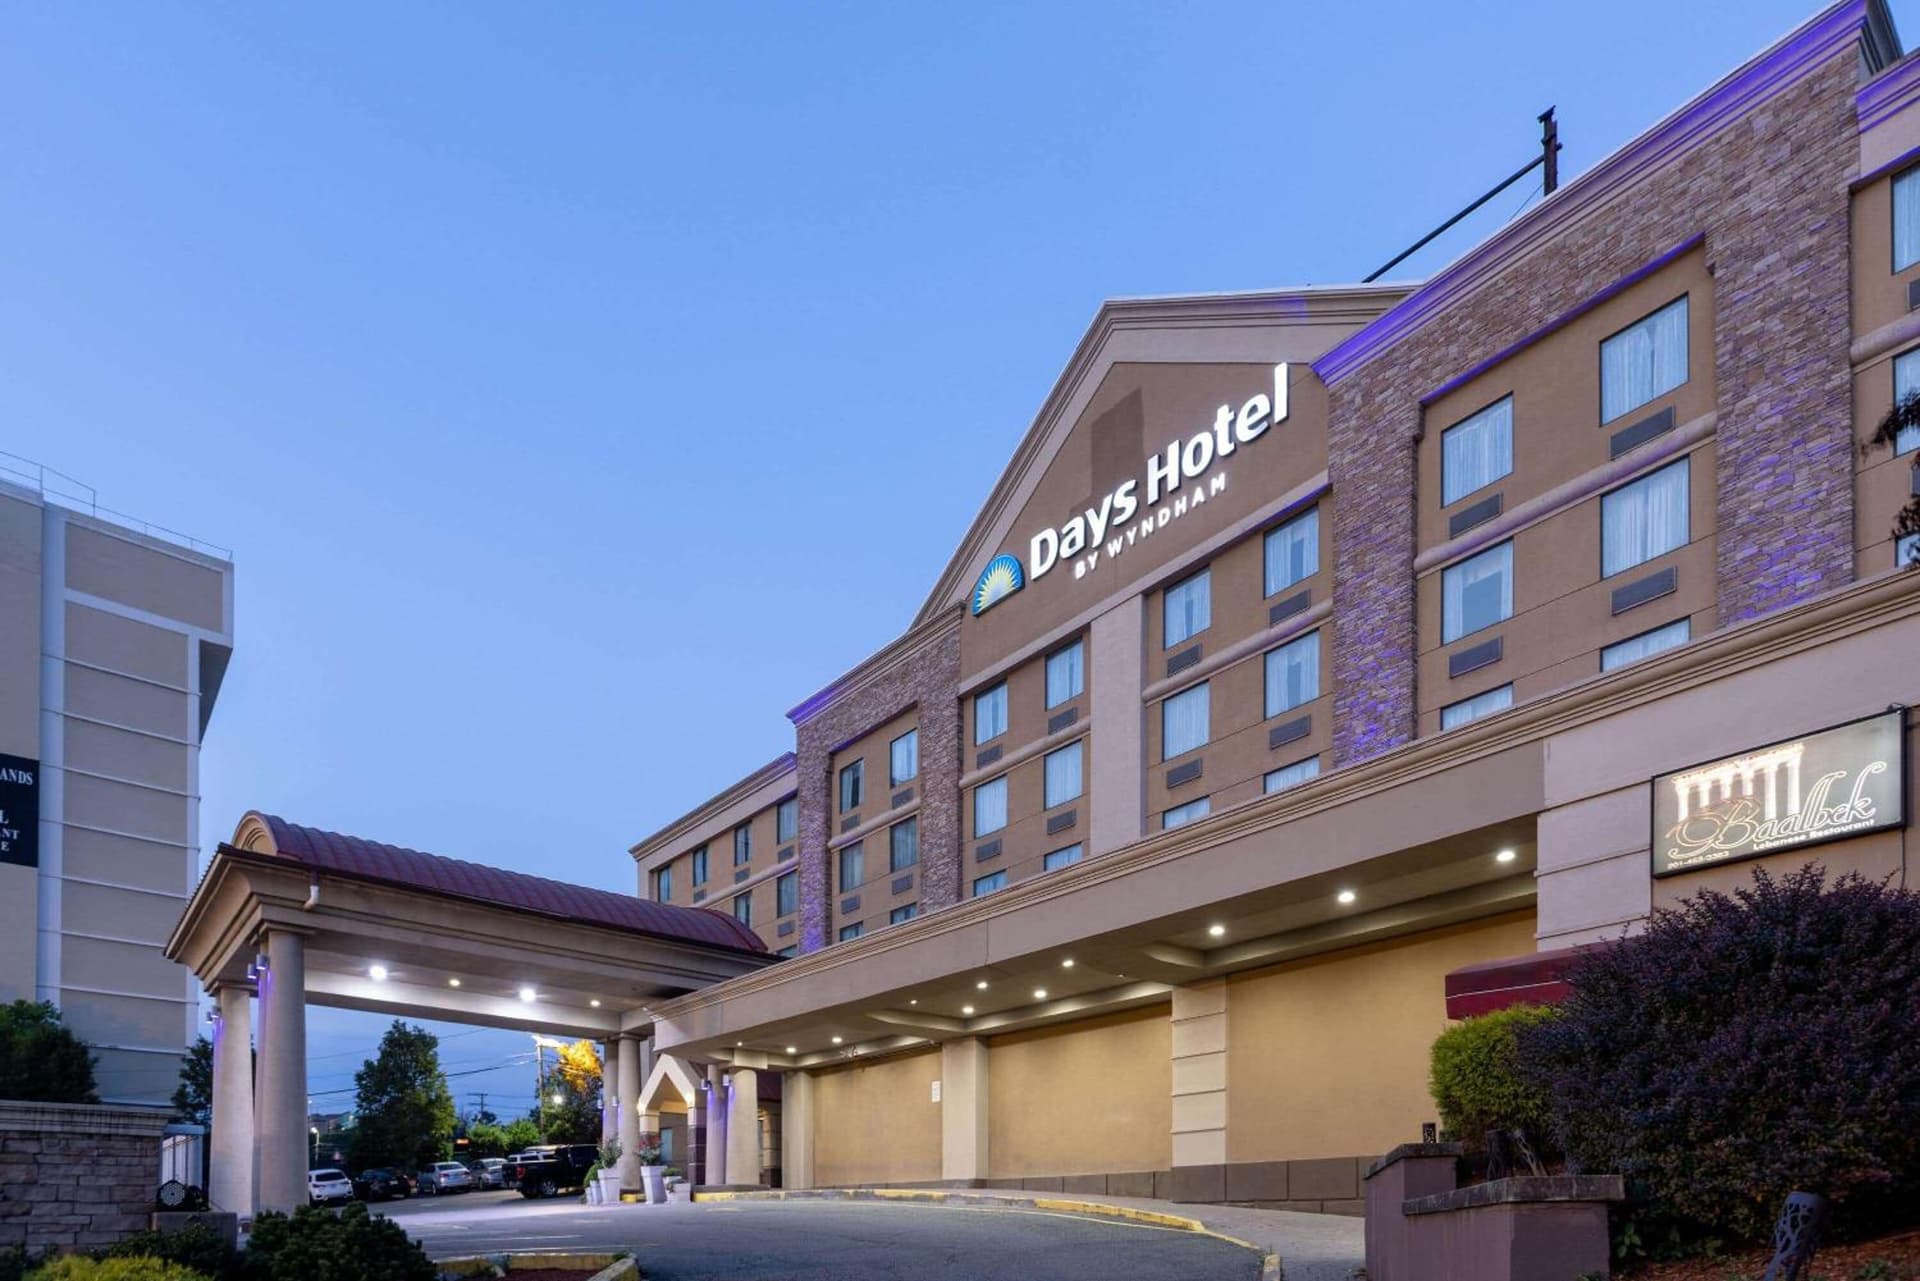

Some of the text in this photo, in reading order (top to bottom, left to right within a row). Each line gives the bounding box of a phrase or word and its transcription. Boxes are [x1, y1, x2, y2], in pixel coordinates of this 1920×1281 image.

[1029, 361, 1289, 582] Days Hotel
[1074, 472, 1227, 581] BY WYNDHAM
[0, 767, 33, 786] ANDS
[1665, 761, 1888, 860] Baalbek
